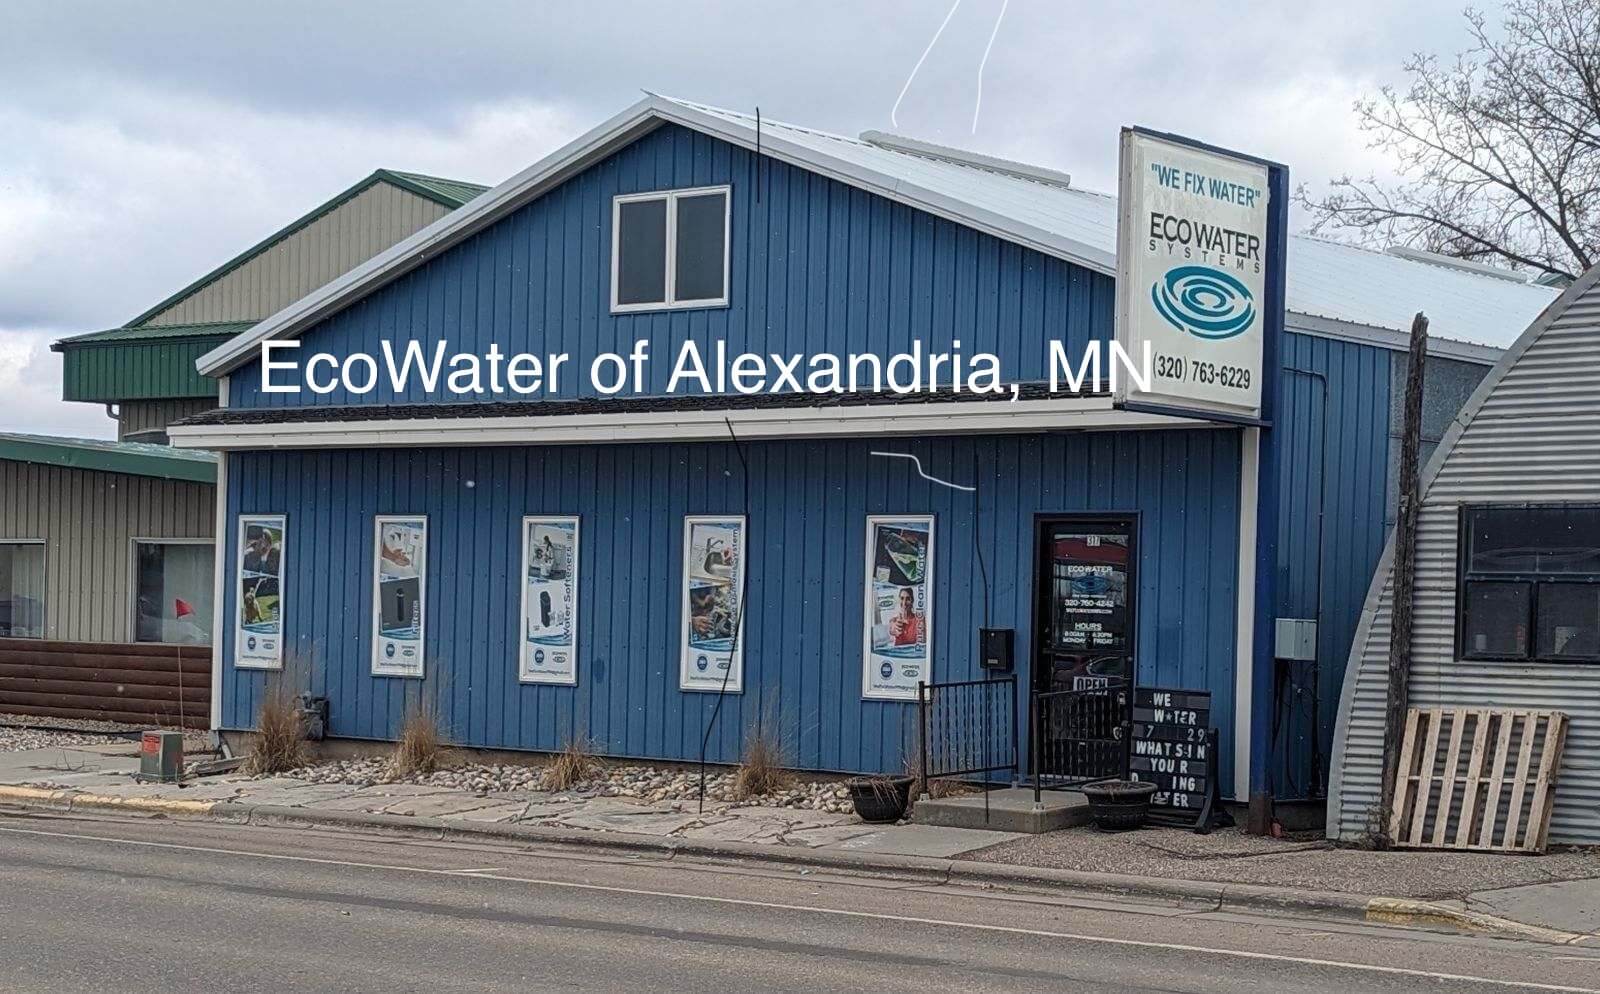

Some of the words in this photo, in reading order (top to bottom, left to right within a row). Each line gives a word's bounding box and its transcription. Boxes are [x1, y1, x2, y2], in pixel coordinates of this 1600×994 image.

[1151, 163, 1180, 190] "WE
[1184, 172, 1205, 196] FIX
[1208, 177, 1261, 208] WATER"
[1149, 239, 1260, 274] SYSTEMS
[1152, 350, 1188, 384] (320)
[1191, 360, 1251, 391] 763-6229
[563, 546, 572, 603] Softeners
[915, 584, 924, 618] Clean
[563, 604, 571, 641] Water
[1075, 622, 1102, 631] HOURS
[1153, 692, 1171, 707] WE
